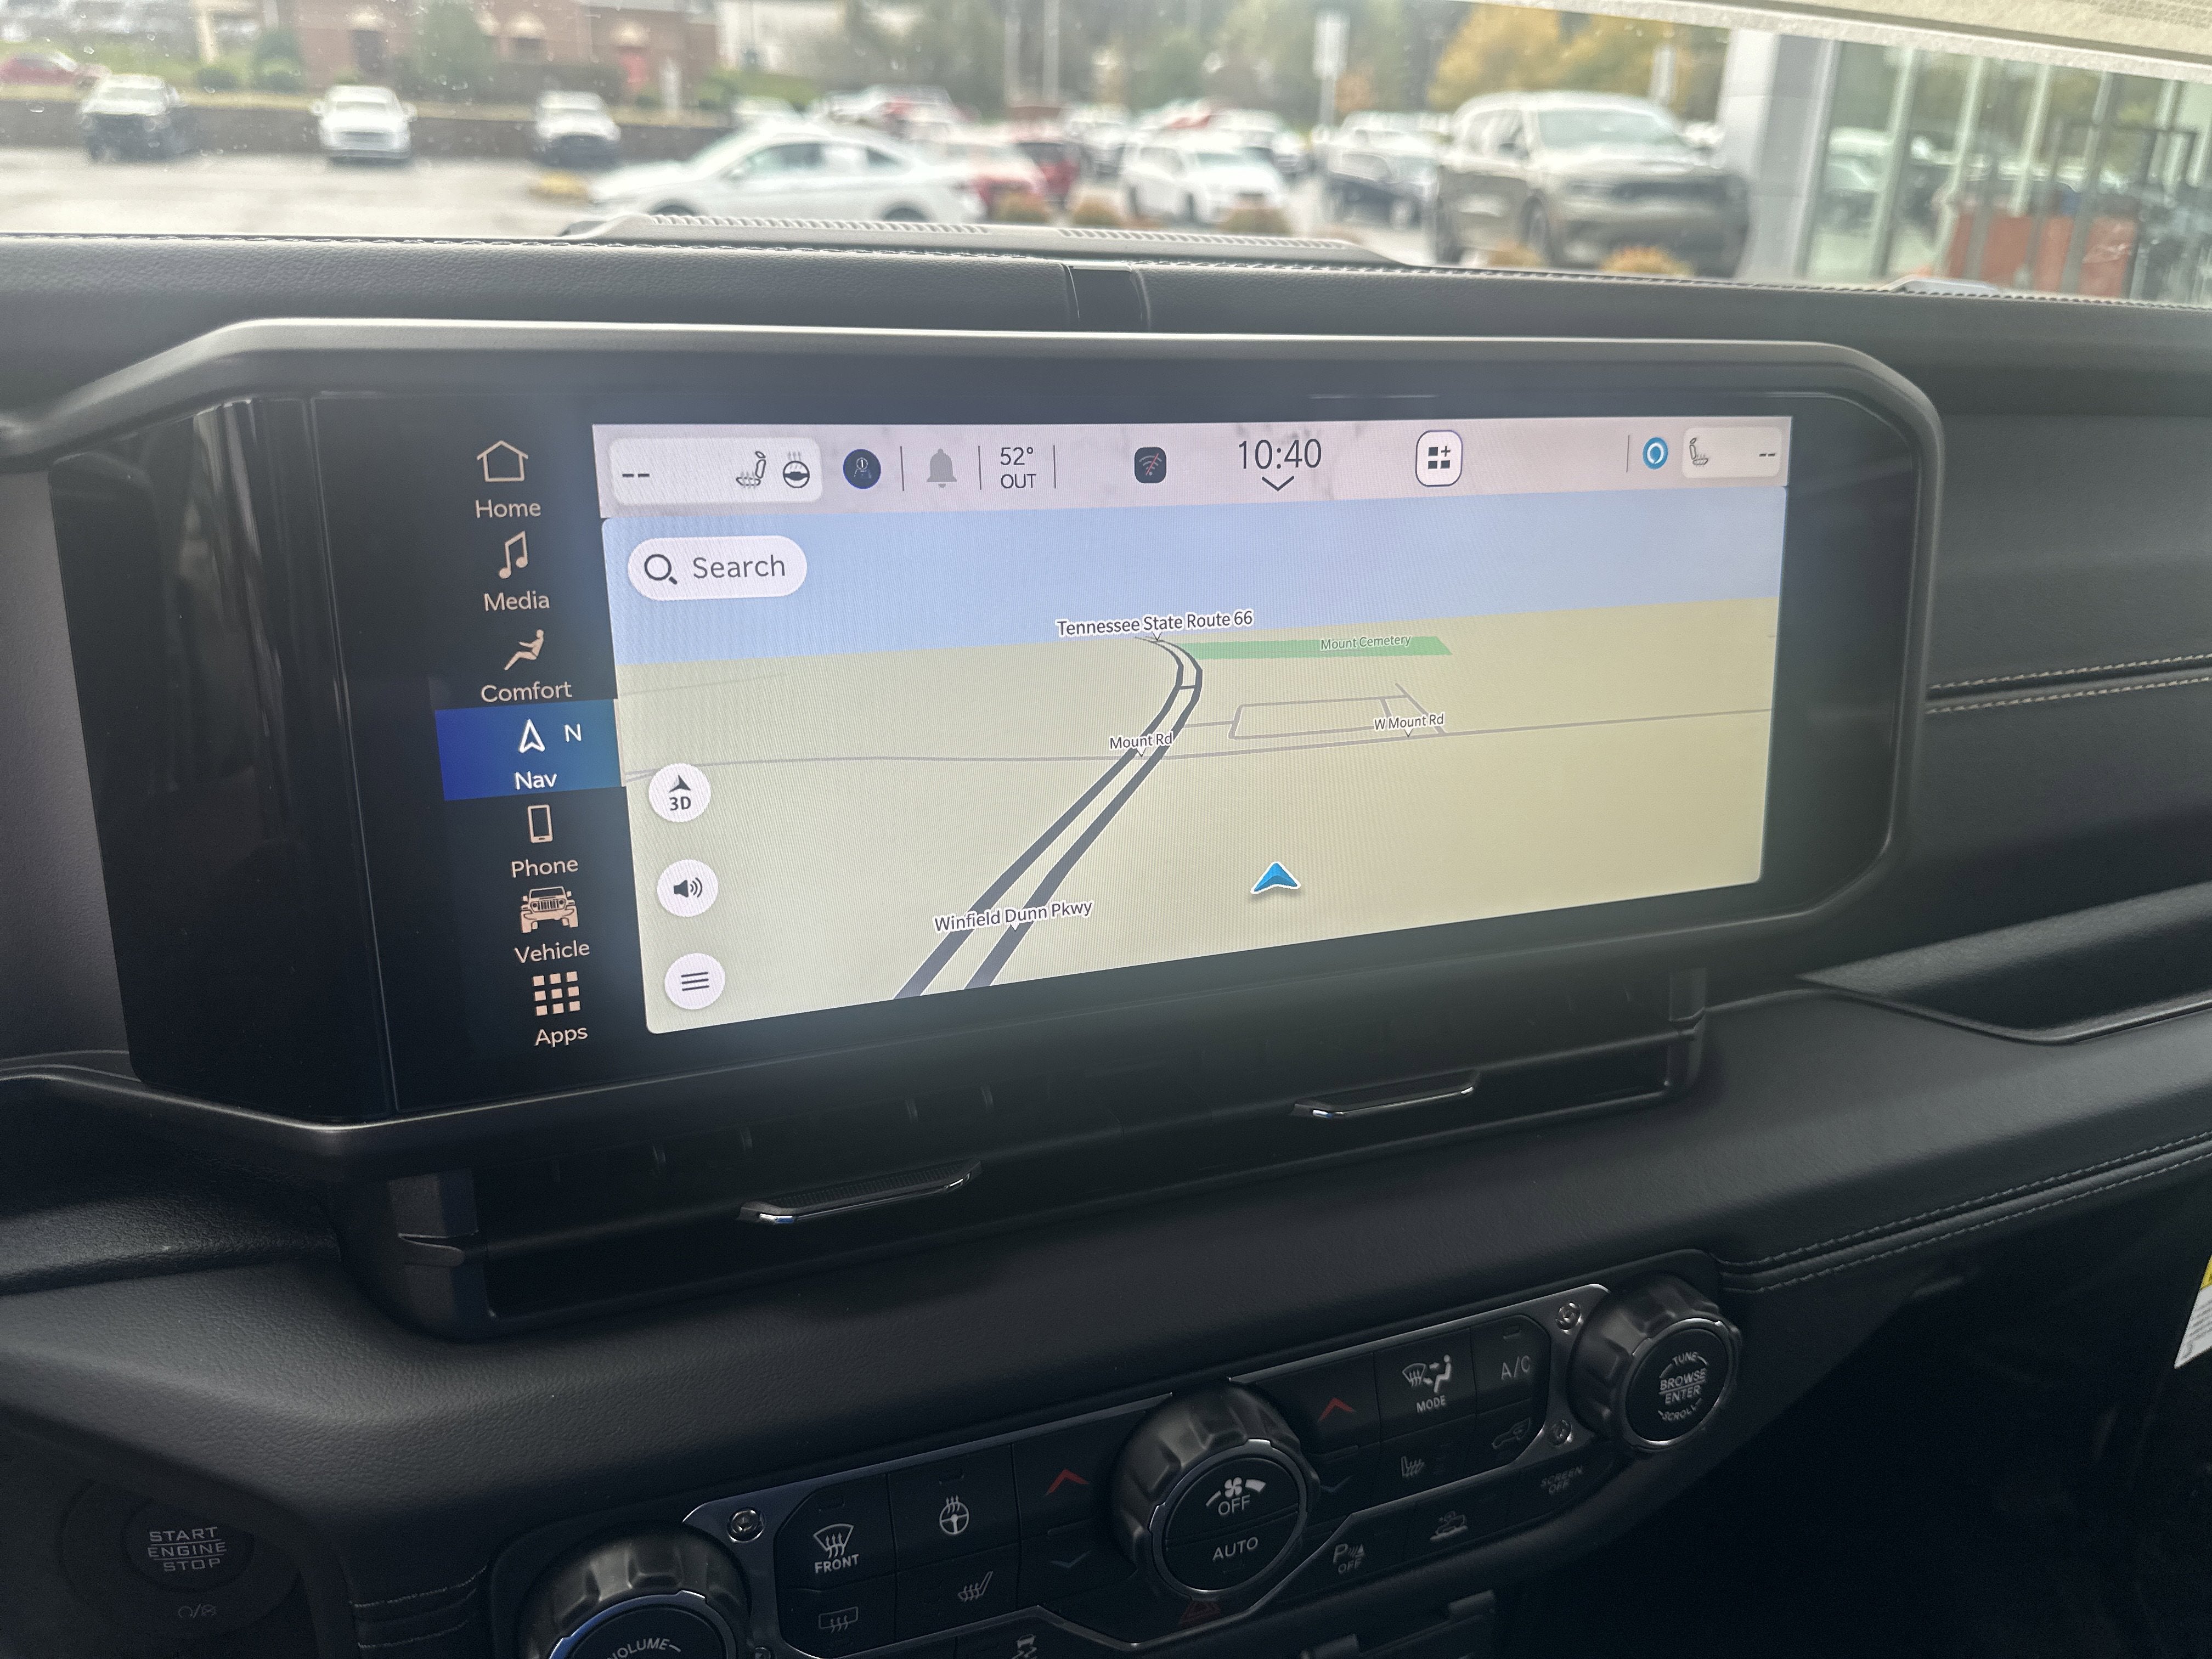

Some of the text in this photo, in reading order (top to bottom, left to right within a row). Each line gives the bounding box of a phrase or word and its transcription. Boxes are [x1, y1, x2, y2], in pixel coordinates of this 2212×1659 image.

[1000, 447, 1034, 466] 52°
[1239, 439, 1322, 470] 10:40
[1001, 473, 1037, 489] OUT
[475, 500, 541, 519] Home
[692, 554, 786, 579] Search
[483, 591, 550, 612] Media
[1057, 610, 1253, 636] Tennessee State Route 66
[1321, 636, 1412, 650] Mount Cemetery
[481, 681, 573, 703] Comfort
[1374, 713, 1444, 730] W Mount Rd
[564, 724, 582, 742] N
[1109, 732, 1173, 749] Mount Rd
[515, 772, 557, 790] Nav
[669, 796, 692, 811] 3D
[511, 859, 579, 878] Phone
[934, 902, 1093, 932] Winfield Dunn Pkwy
[514, 940, 590, 963] Vehicle
[535, 1025, 588, 1047] Apps
[1501, 1355, 1531, 1380] A/C
[1672, 1351, 1699, 1367] TUNE
[1660, 1367, 1707, 1391] BROWSE
[1416, 1395, 1447, 1413] MODE
[1664, 1384, 1701, 1405] ENTER
[1662, 1404, 1697, 1421] SCROLL
[1540, 1465, 1583, 1487] SCREEN
[1549, 1479, 1570, 1495] OFF
[1218, 1494, 1251, 1516] OFF
[149, 1526, 219, 1543] START
[147, 1541, 227, 1559] ENGINE
[1212, 1536, 1259, 1562] AUTO
[163, 1558, 221, 1572] STOP
[814, 1553, 859, 1574] FRONT
[1338, 1558, 1362, 1575] OFF
